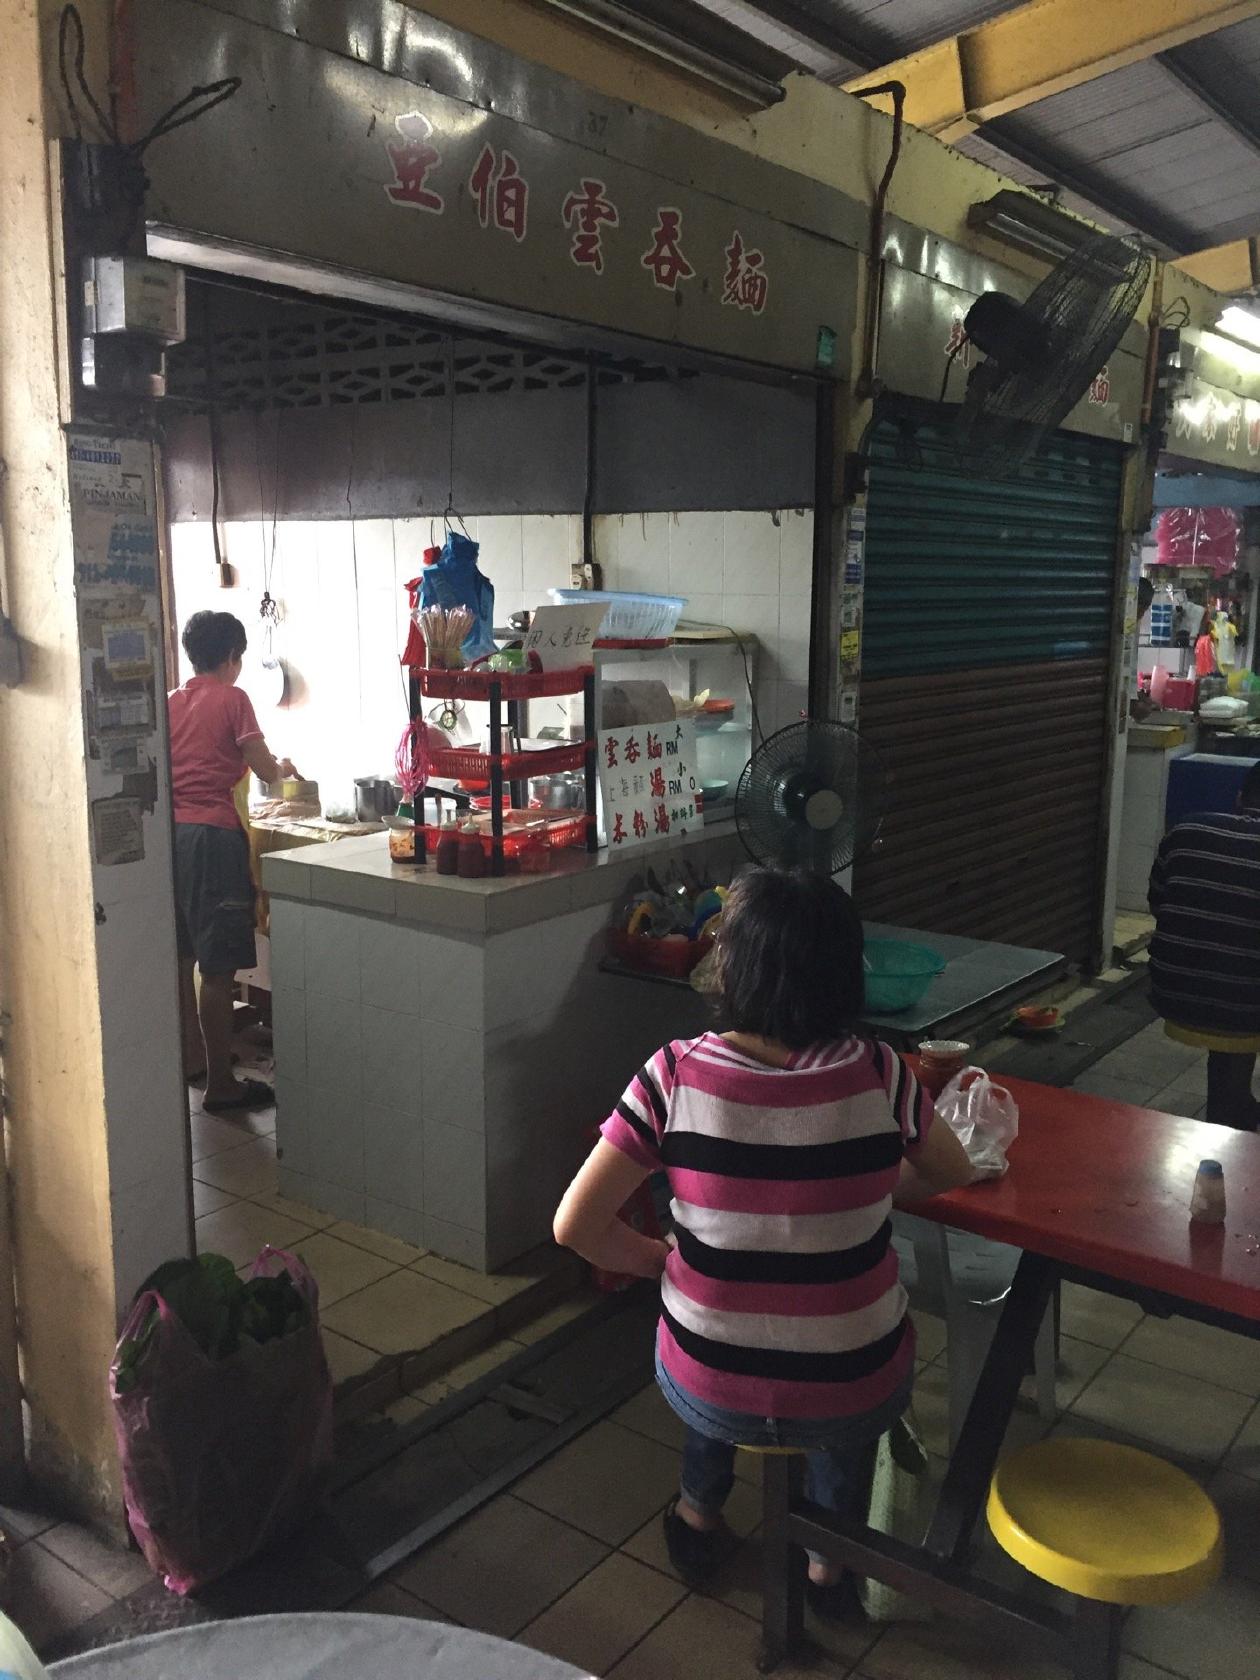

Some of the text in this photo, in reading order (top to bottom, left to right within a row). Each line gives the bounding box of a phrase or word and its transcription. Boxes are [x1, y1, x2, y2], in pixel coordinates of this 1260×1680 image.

[83, 488, 141, 501] PINJAMAN
[666, 741, 678, 756] RM
[677, 761, 687, 777] 小
[669, 780, 682, 795] RM
